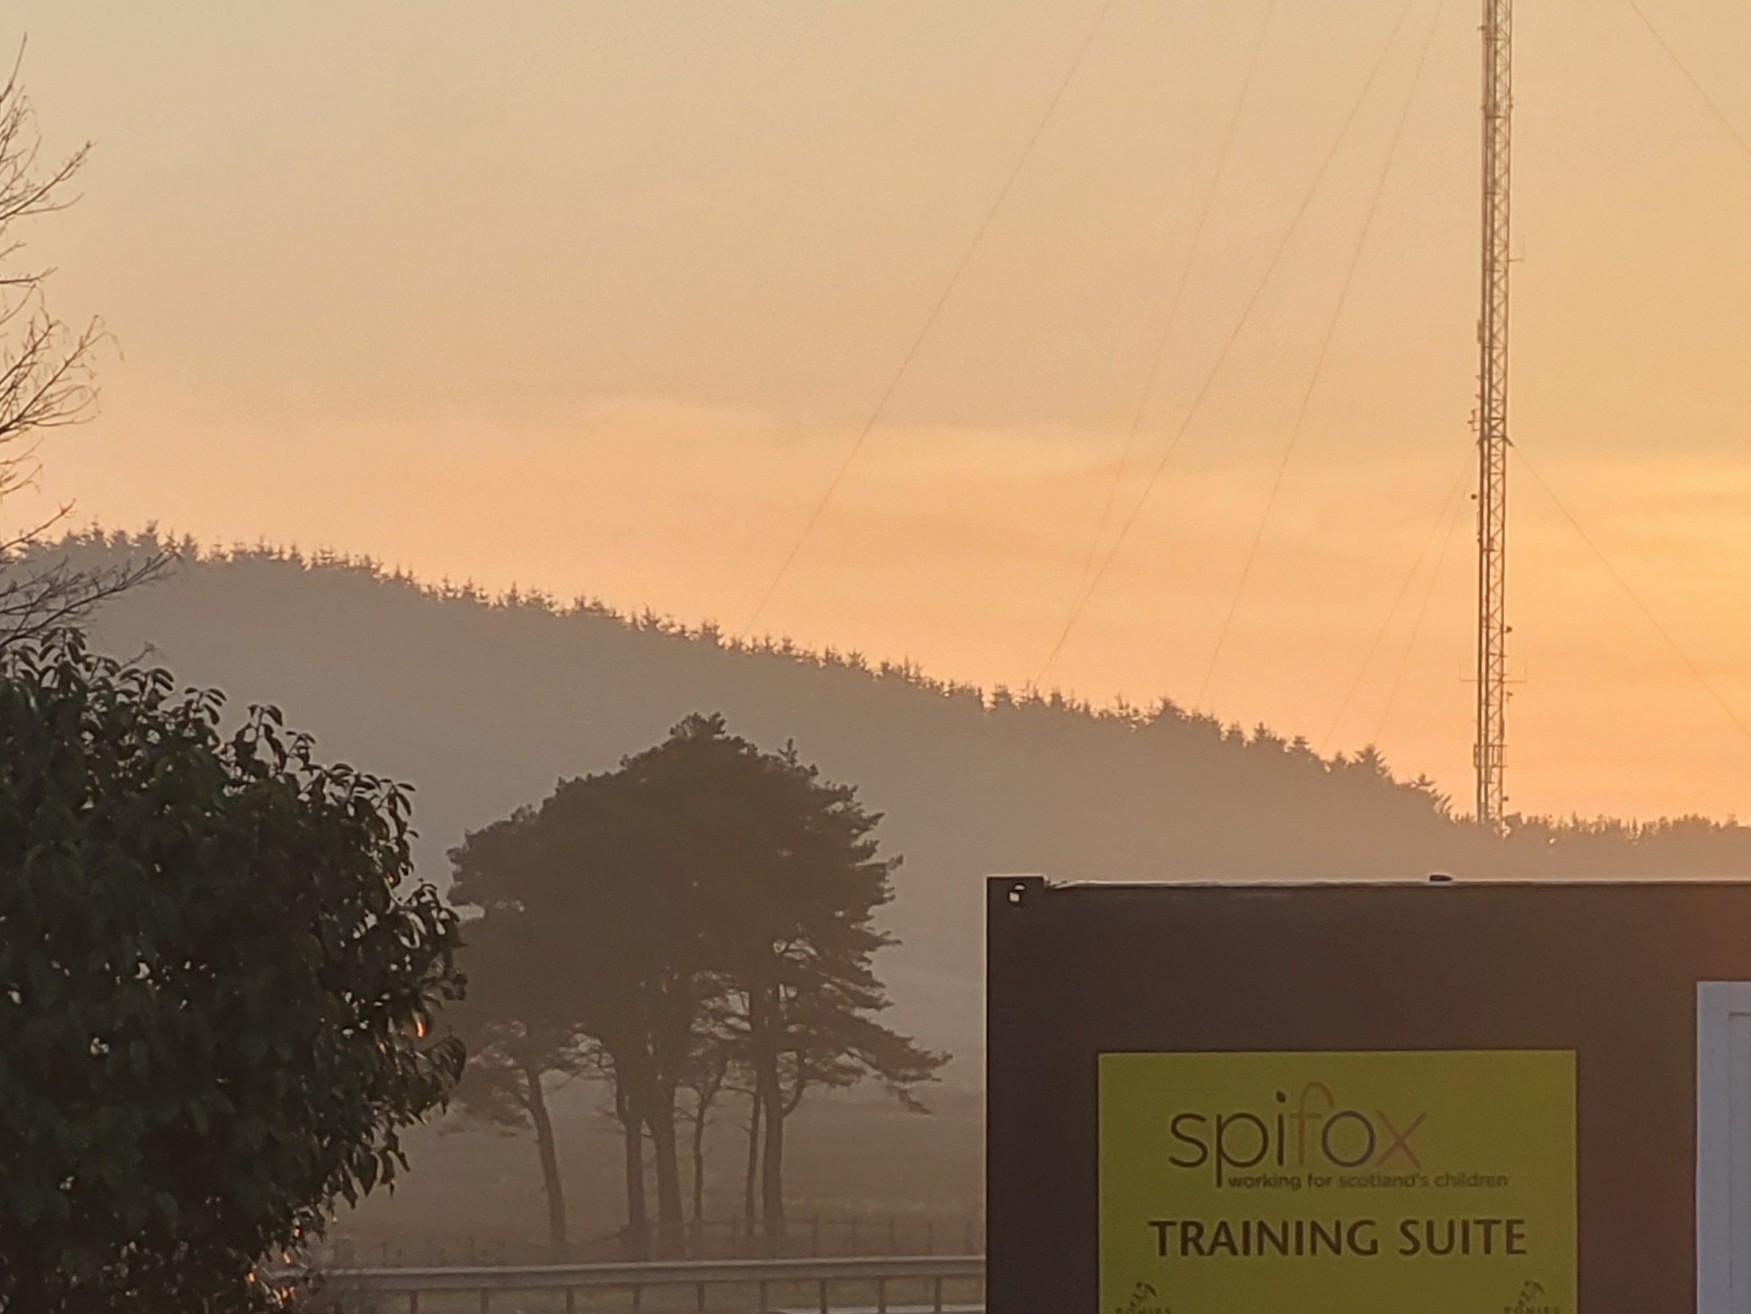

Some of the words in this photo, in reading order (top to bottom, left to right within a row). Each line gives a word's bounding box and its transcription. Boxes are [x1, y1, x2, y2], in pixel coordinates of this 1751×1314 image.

[1168, 1081, 1427, 1188] spifox
[1228, 1172, 1301, 1191] working
[1307, 1172, 1333, 1188] for
[1434, 1171, 1509, 1188] children
[1148, 1219, 1380, 1257] TRAINING
[1398, 1218, 1528, 1256] SUITE
